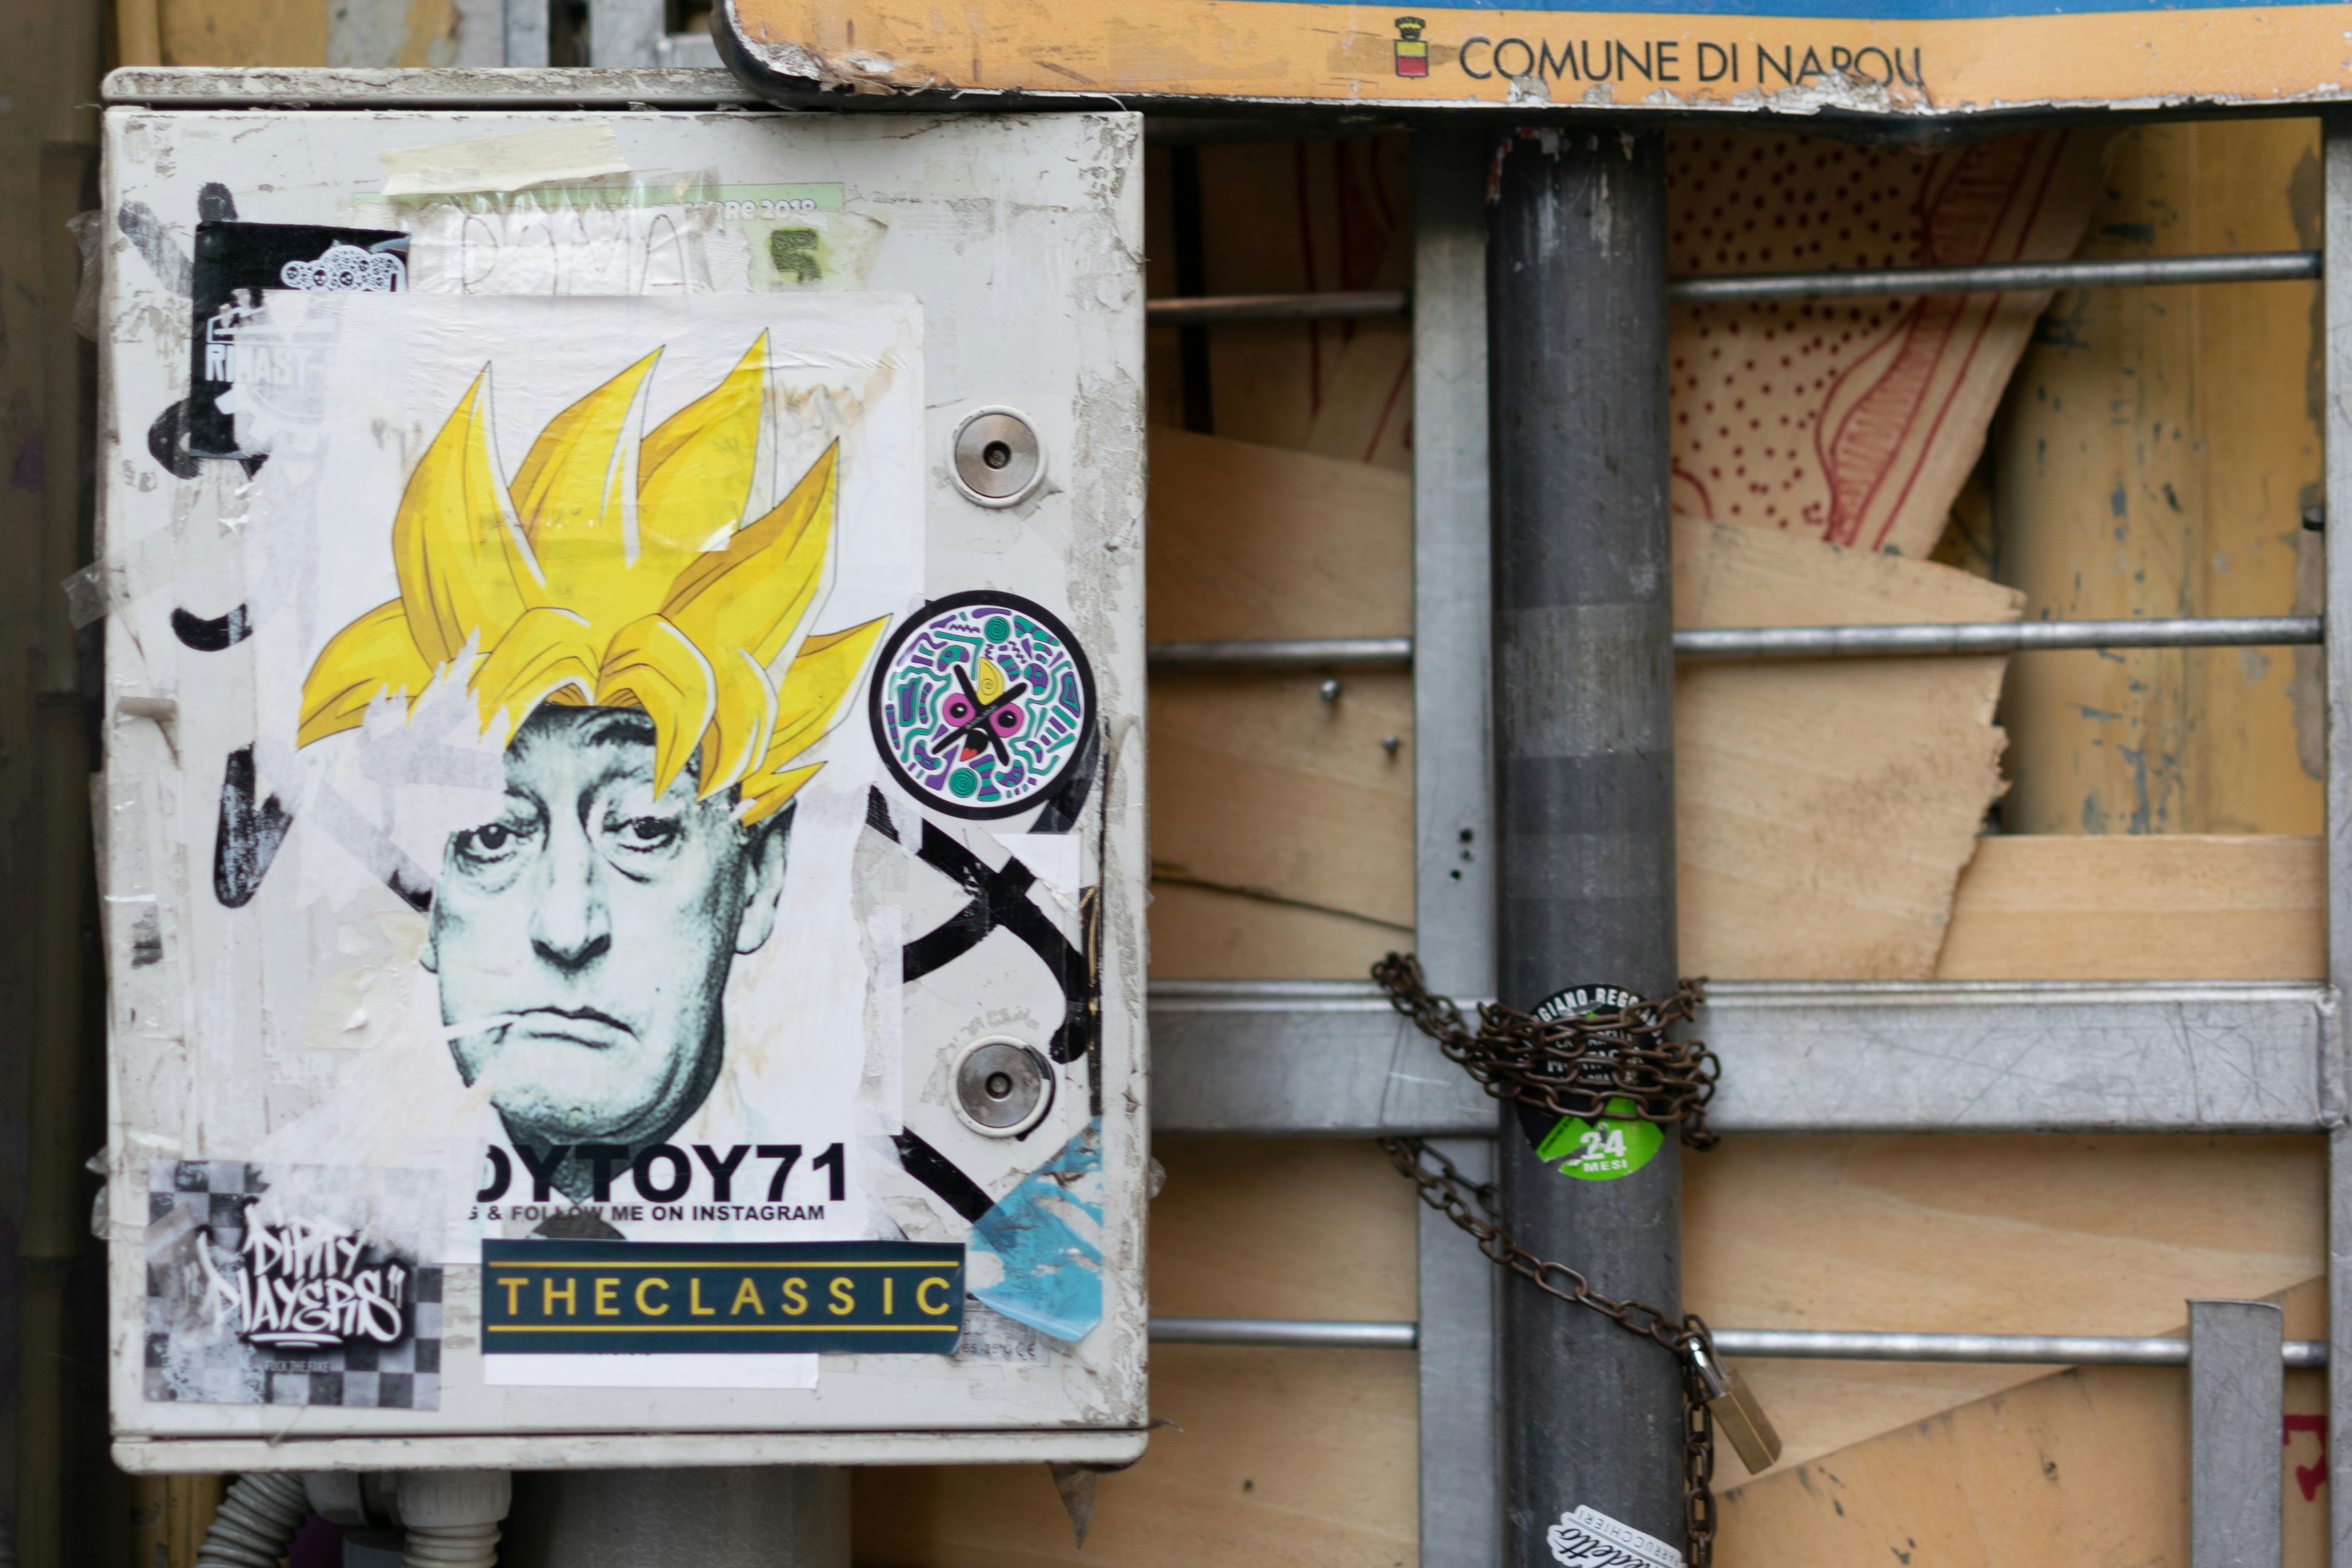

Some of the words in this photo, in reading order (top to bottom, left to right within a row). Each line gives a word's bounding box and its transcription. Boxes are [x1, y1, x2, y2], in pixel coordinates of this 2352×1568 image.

[1459, 37, 1679, 82] COMUNE
[1698, 42, 1738, 83] DI
[1580, 1129, 1627, 1160] 24
[1583, 1159, 1628, 1172] MESI
[511, 1205, 604, 1221] FOLLOW
[612, 1206, 643, 1221] ME
[652, 1206, 684, 1221] ON
[692, 1205, 825, 1221] INSTAGRAM
[243, 1201, 376, 1279] DIRTY
[290, 1360, 306, 1371] THE
[308, 1361, 330, 1373] FAKE
